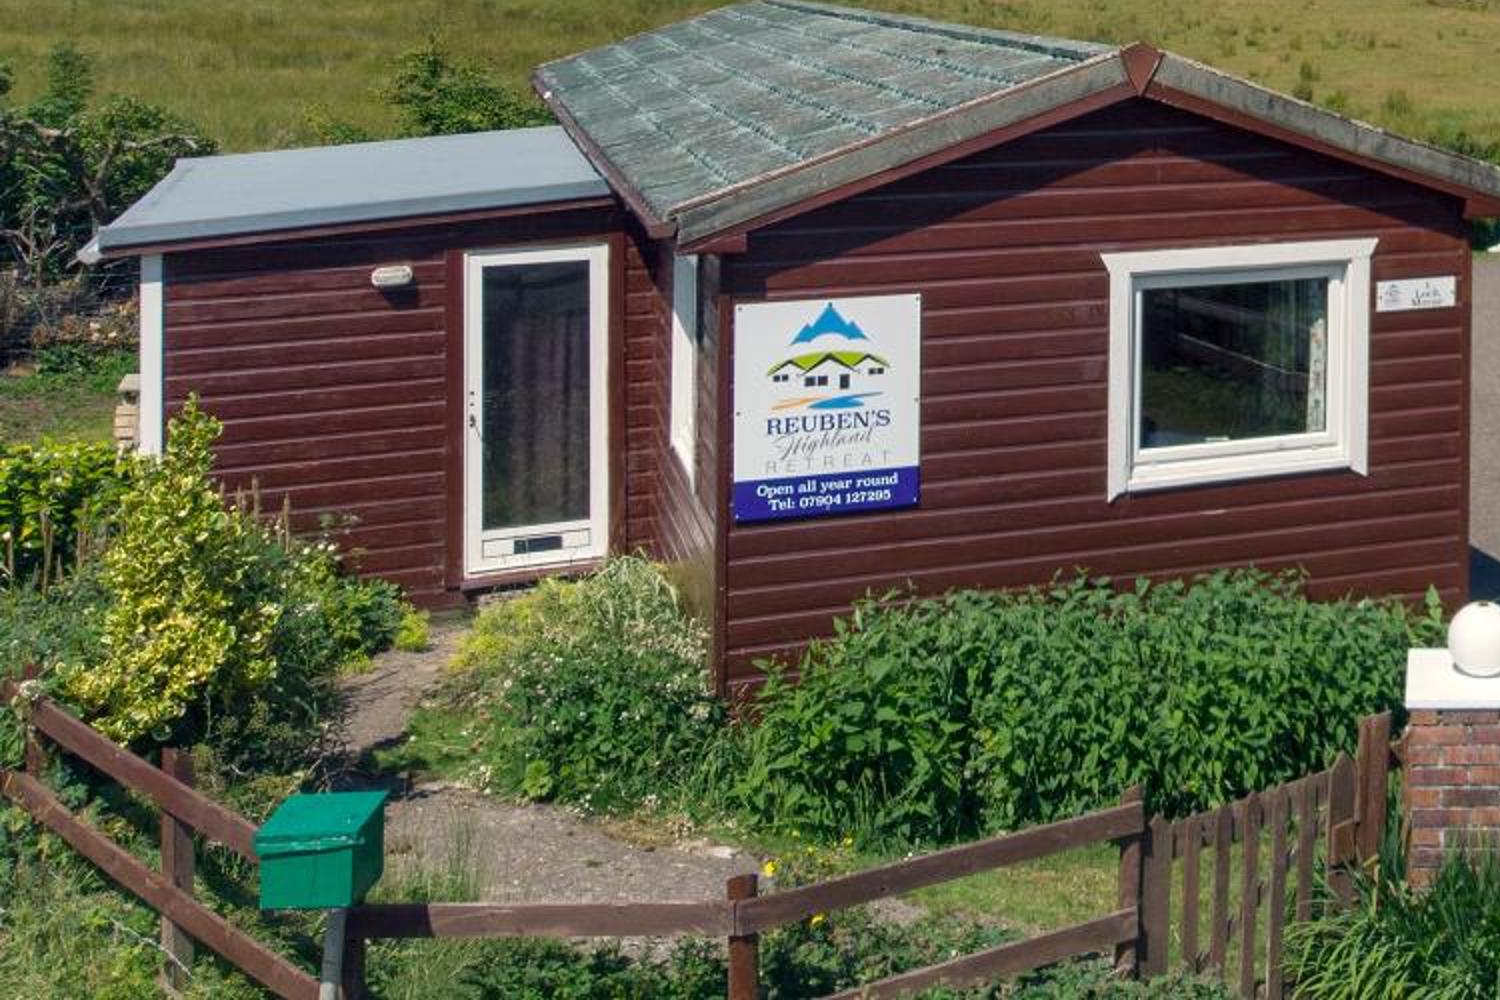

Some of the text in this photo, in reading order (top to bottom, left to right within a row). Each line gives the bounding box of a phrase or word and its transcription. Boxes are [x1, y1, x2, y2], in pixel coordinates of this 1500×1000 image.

[766, 409, 891, 435] REUBEN'S
[765, 450, 891, 473] RETREAT
[757, 472, 899, 499] Open all year round
[768, 498, 796, 511] Tel:
